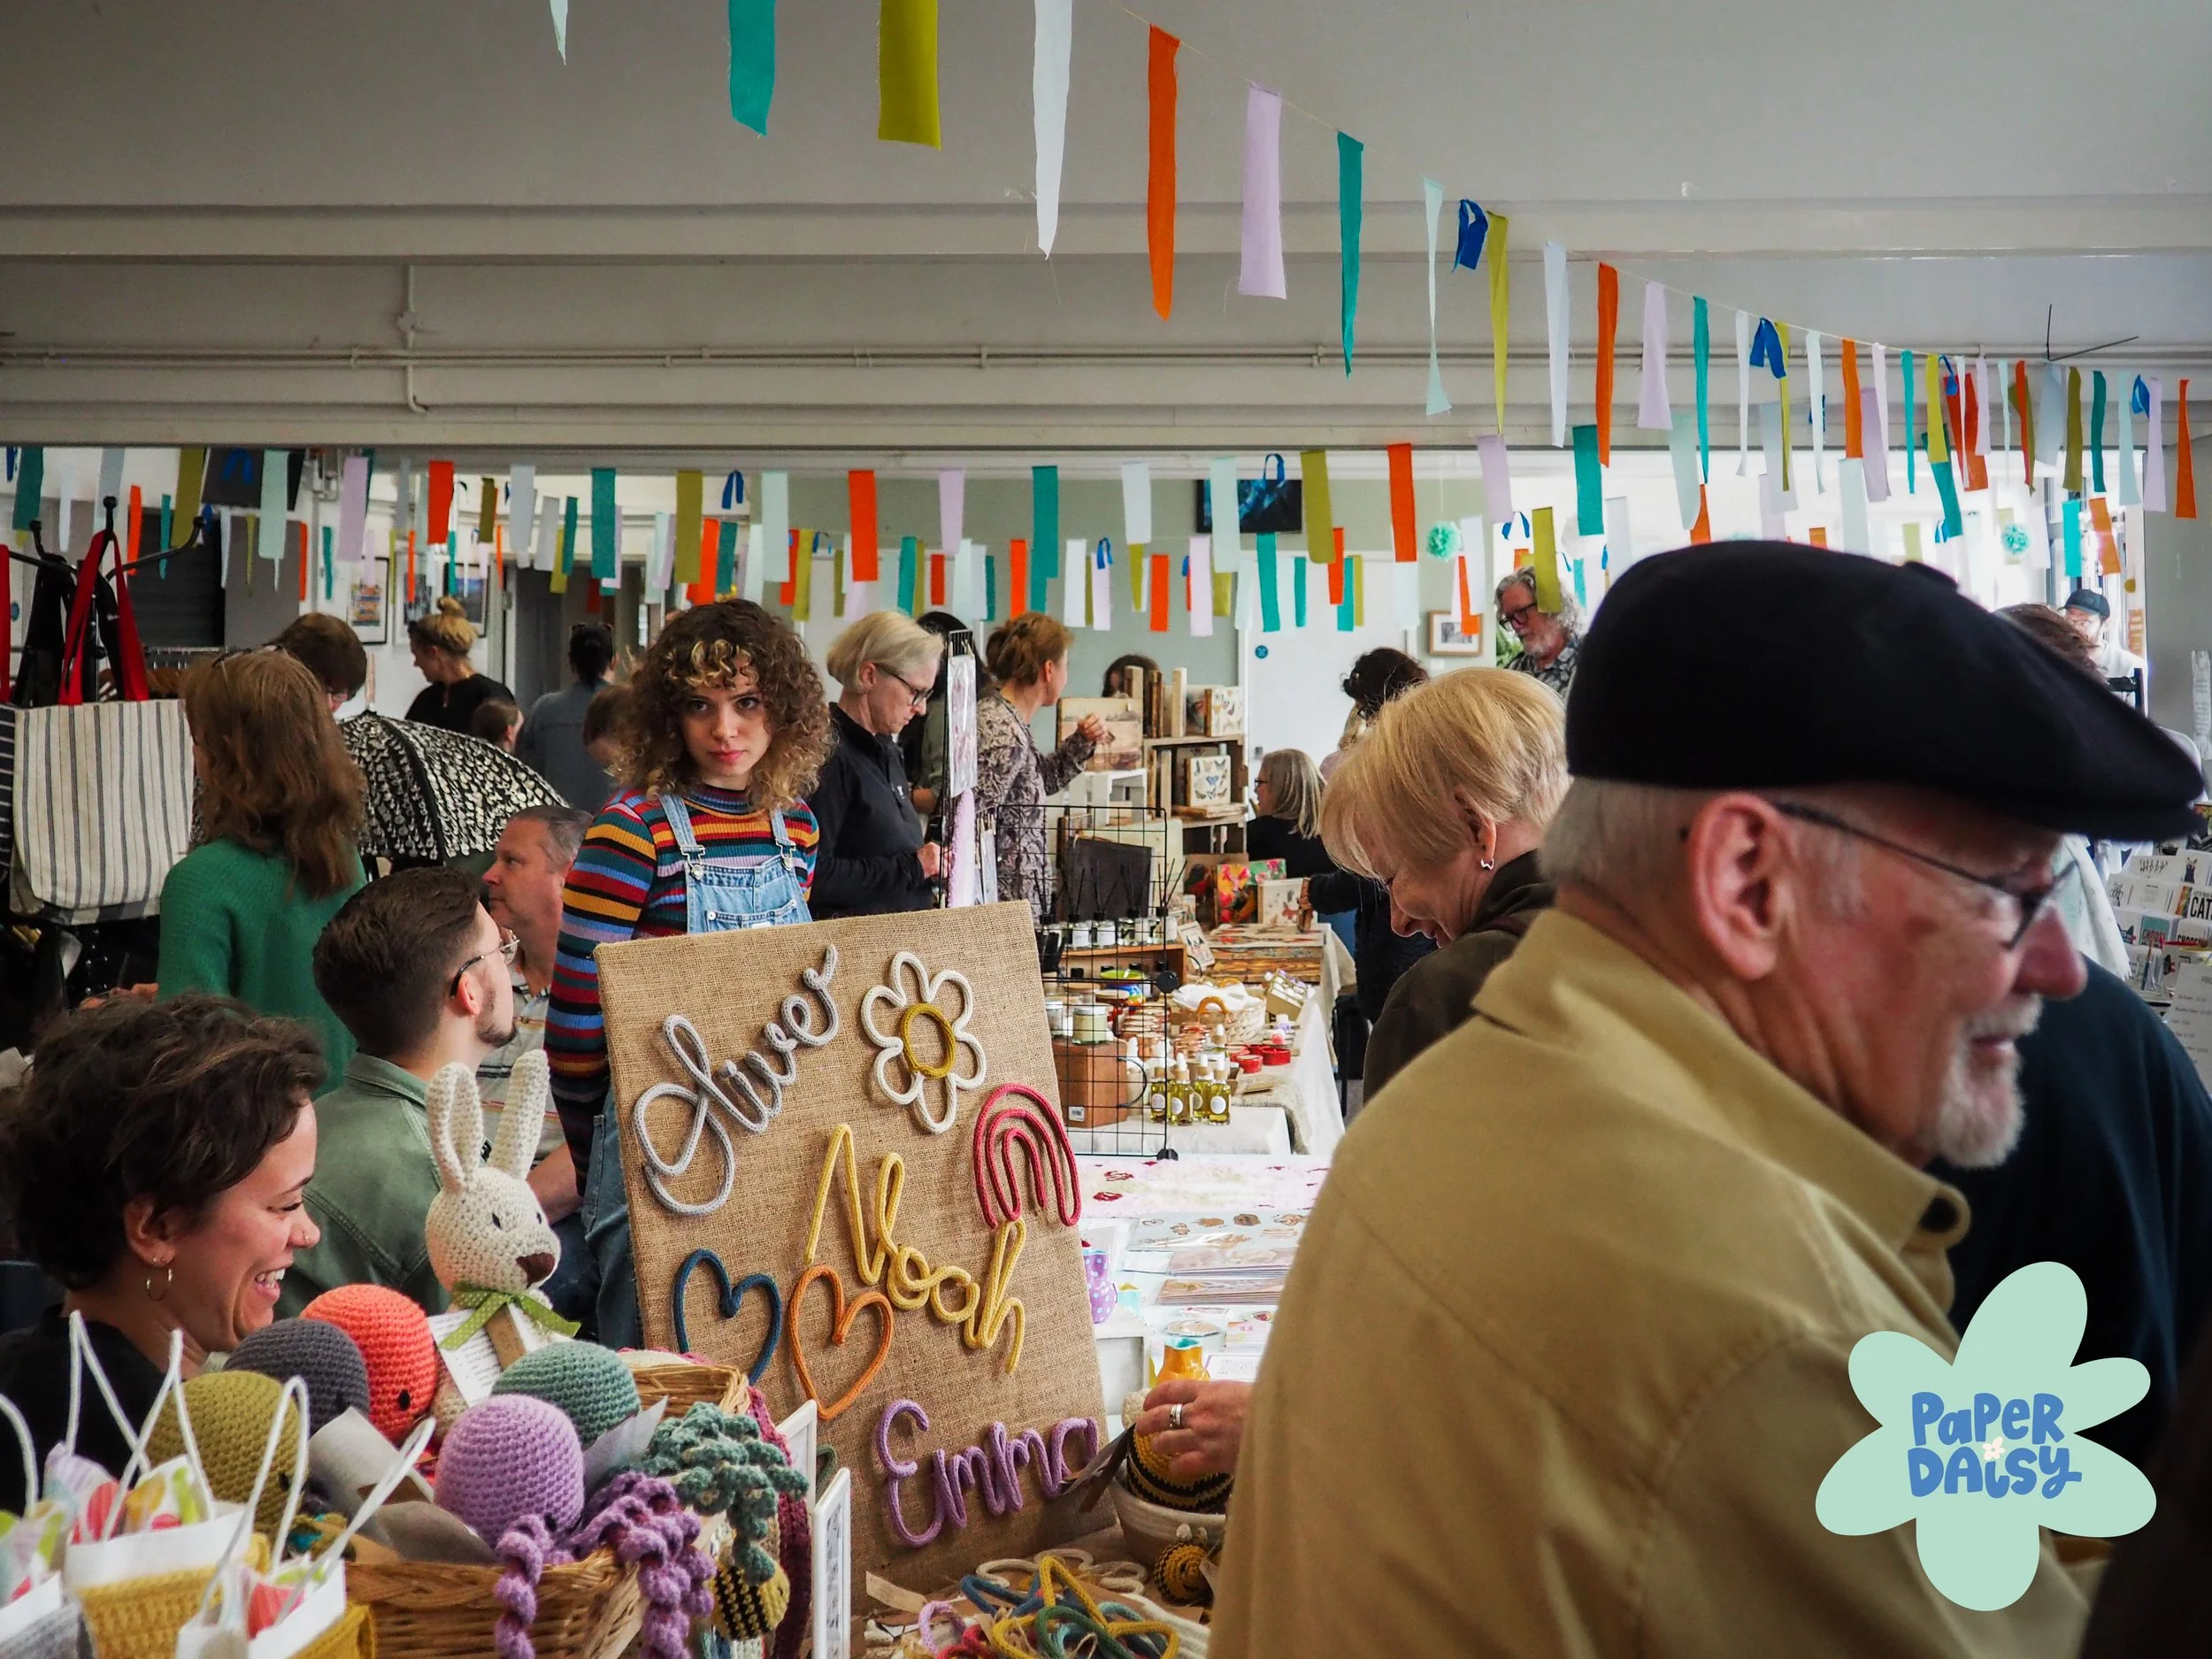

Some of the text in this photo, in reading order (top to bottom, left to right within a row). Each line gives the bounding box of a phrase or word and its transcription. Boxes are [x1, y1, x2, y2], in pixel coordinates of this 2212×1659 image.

[2190, 895, 2212, 920] CAT
[803, 1124, 1026, 1374] Noah
[877, 1399, 1099, 1548] Emma
